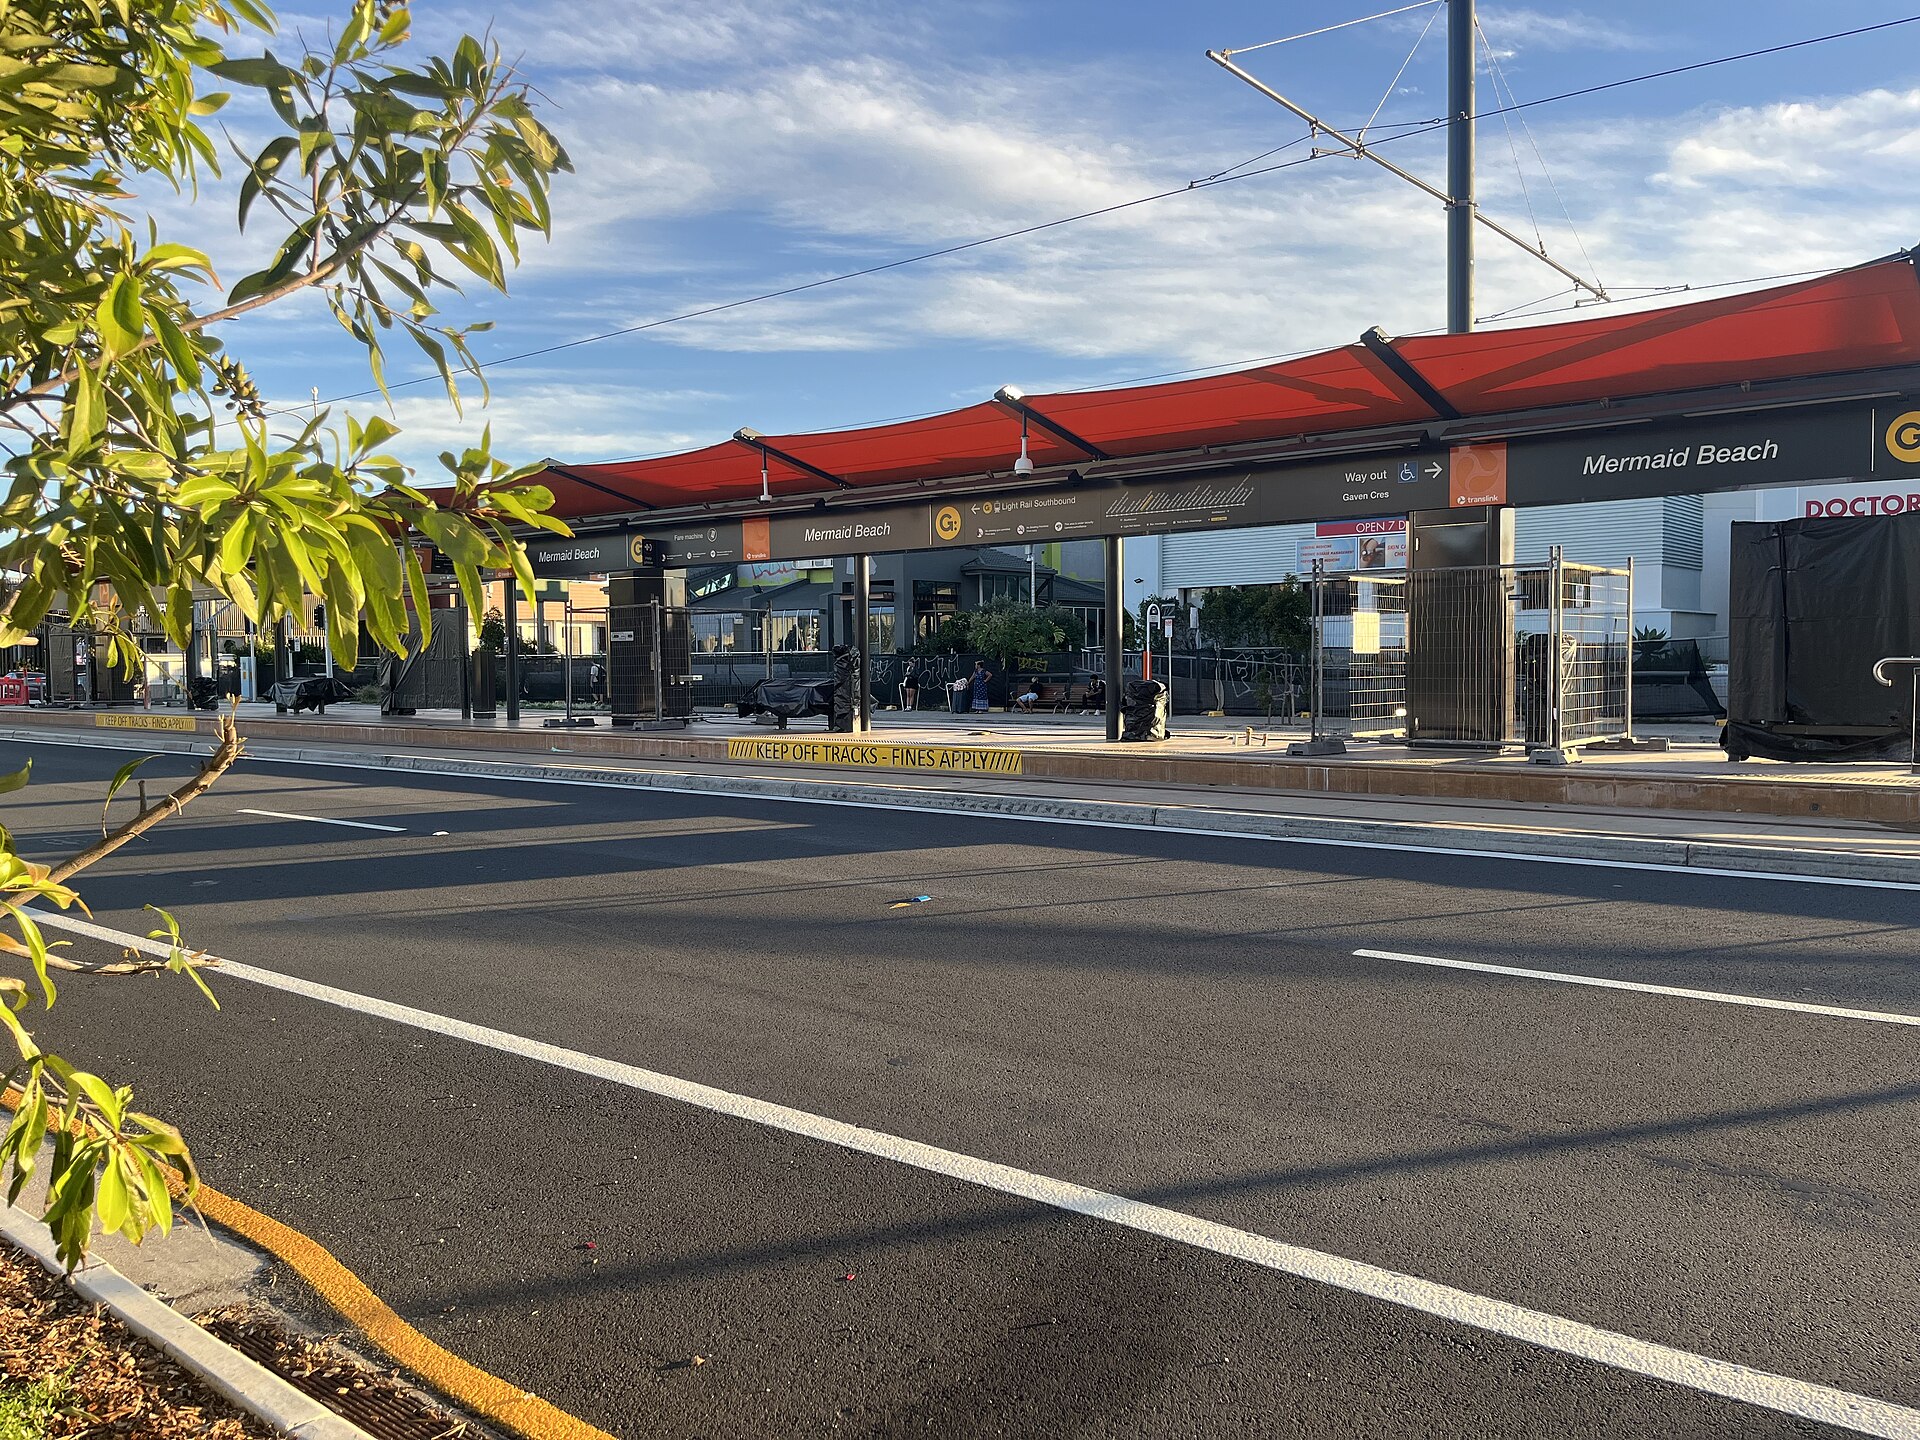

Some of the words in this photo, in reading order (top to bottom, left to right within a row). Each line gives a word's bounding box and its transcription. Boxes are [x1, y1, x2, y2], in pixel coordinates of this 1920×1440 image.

[1582, 446, 1690, 475] Mermaid
[1696, 439, 1779, 466] Beach
[1344, 471, 1367, 484] Way
[1370, 470, 1387, 480] out
[1001, 502, 1019, 512] Light
[1019, 500, 1033, 509] Rail
[1034, 496, 1076, 508] Southbound
[1342, 493, 1368, 502] Gaven
[1370, 491, 1390, 500] Cres
[1467, 494, 1498, 504] translink
[804, 525, 851, 542] Mermaid
[854, 522, 891, 538] Beach
[1355, 521, 1385, 533] OPEN
[1388, 520, 1395, 531] 7
[673, 534, 684, 542] Fare
[684, 532, 704, 541] machine
[538, 549, 573, 563] Mermaid
[574, 546, 600, 560] Beach
[104, 714, 117, 726] KEEP
[118, 715, 128, 726] OFF
[129, 716, 148, 728] TRACKS
[152, 717, 167, 729] FINES
[168, 718, 185, 730] APPLY
[756, 743, 788, 759] KEEP
[792, 744, 819, 761] OFF
[823, 745, 878, 765] TRACKS
[892, 748, 935, 767] FINES
[939, 750, 988, 770] APPLY
